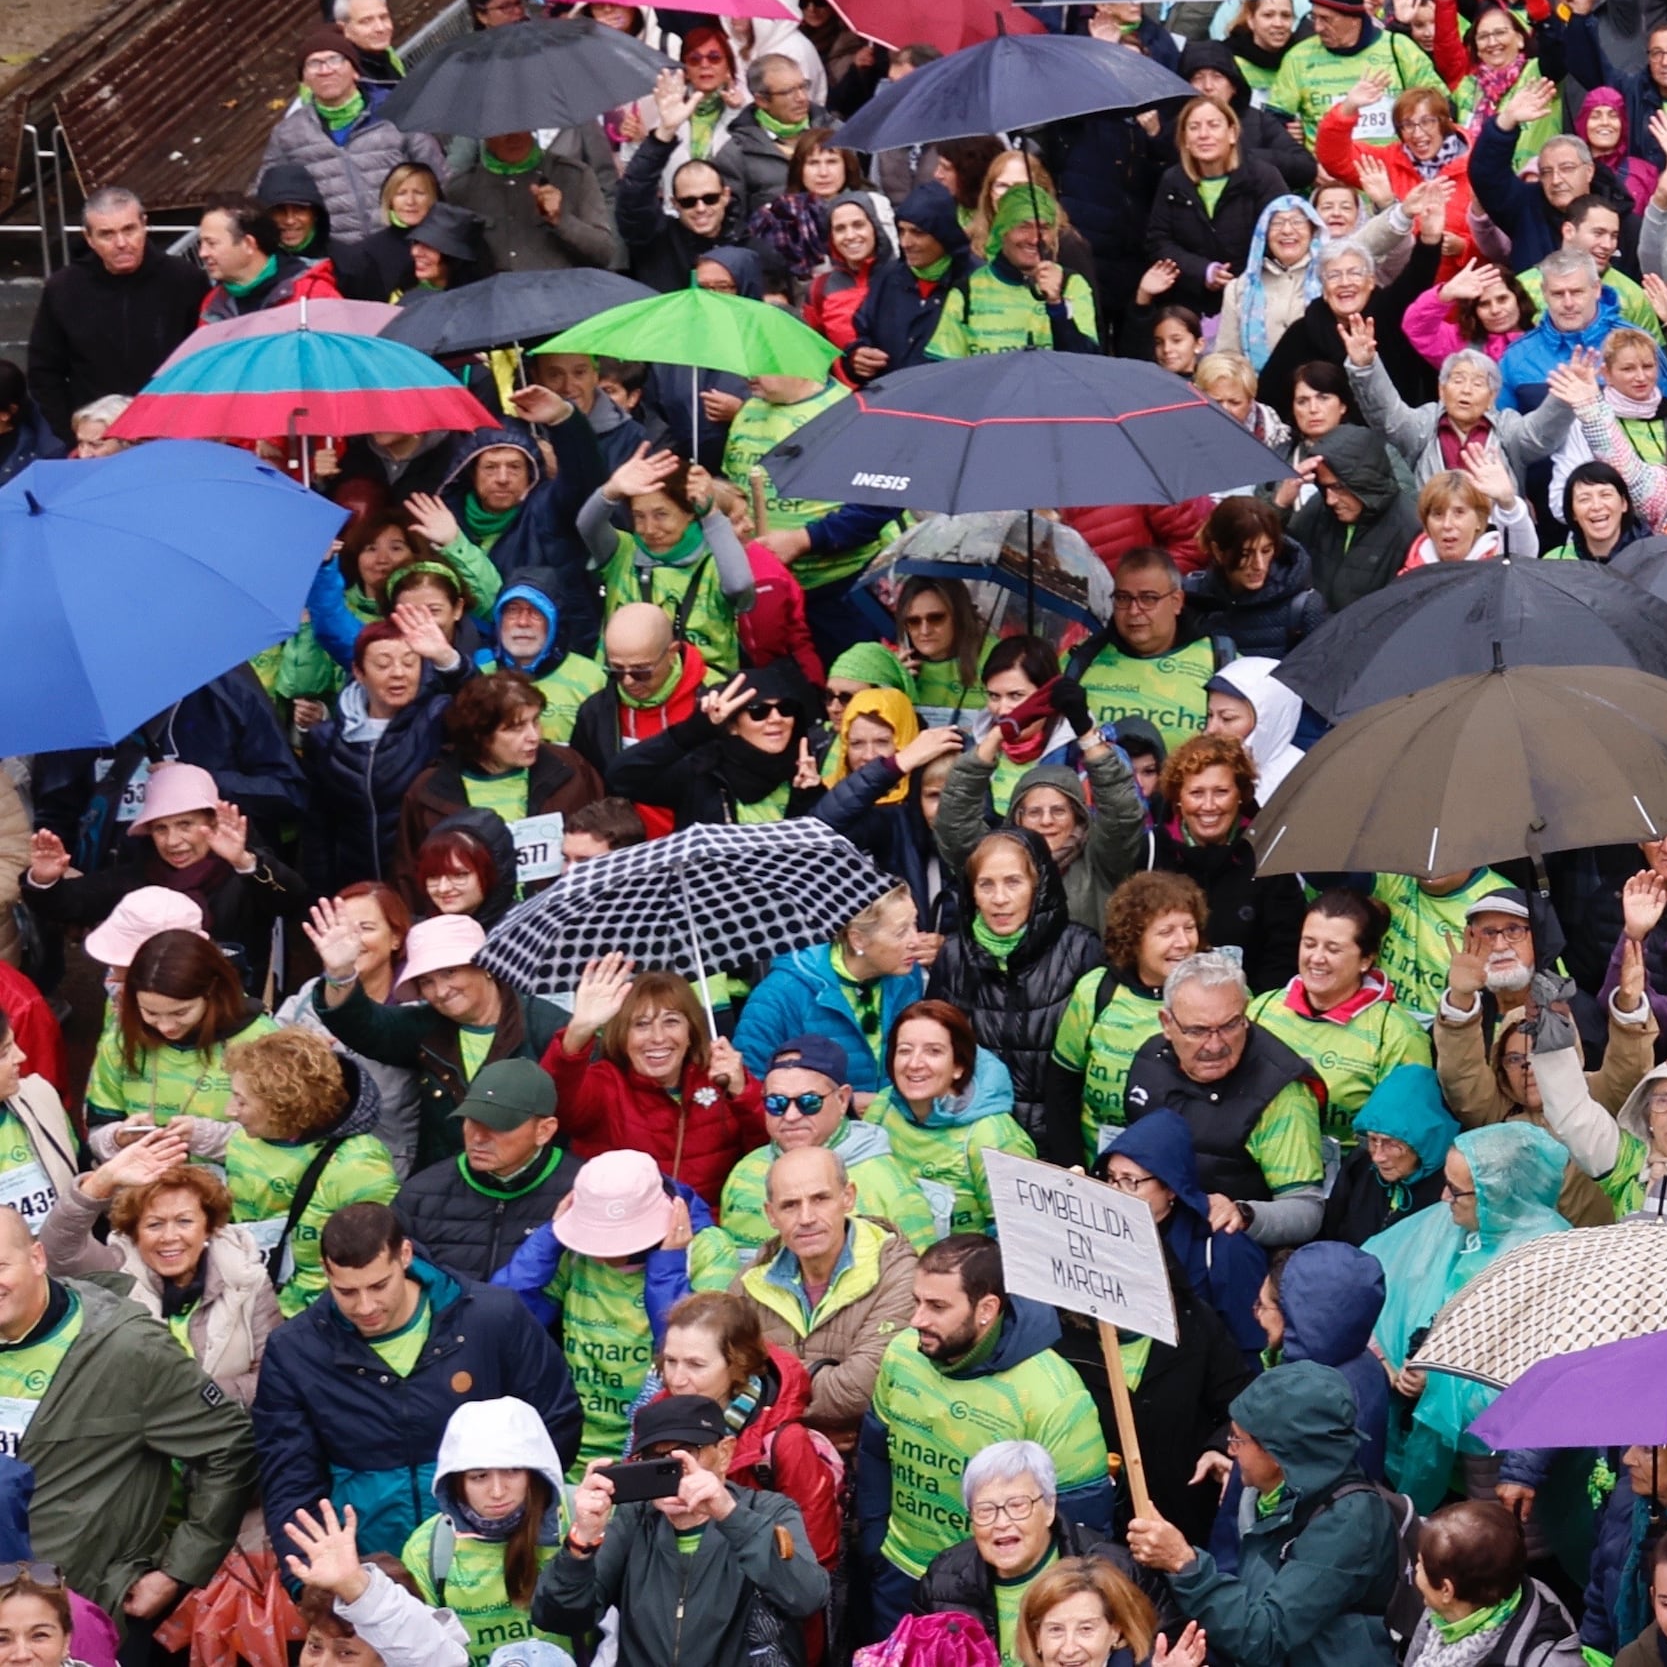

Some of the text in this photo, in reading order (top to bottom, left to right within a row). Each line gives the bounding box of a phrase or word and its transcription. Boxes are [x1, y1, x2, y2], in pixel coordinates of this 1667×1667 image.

[852, 471, 912, 493] INESIS
[1015, 1178, 1136, 1243] FOMBELLIDA
[1066, 1228, 1096, 1263] EN
[1051, 1257, 1129, 1308] MARCHA
